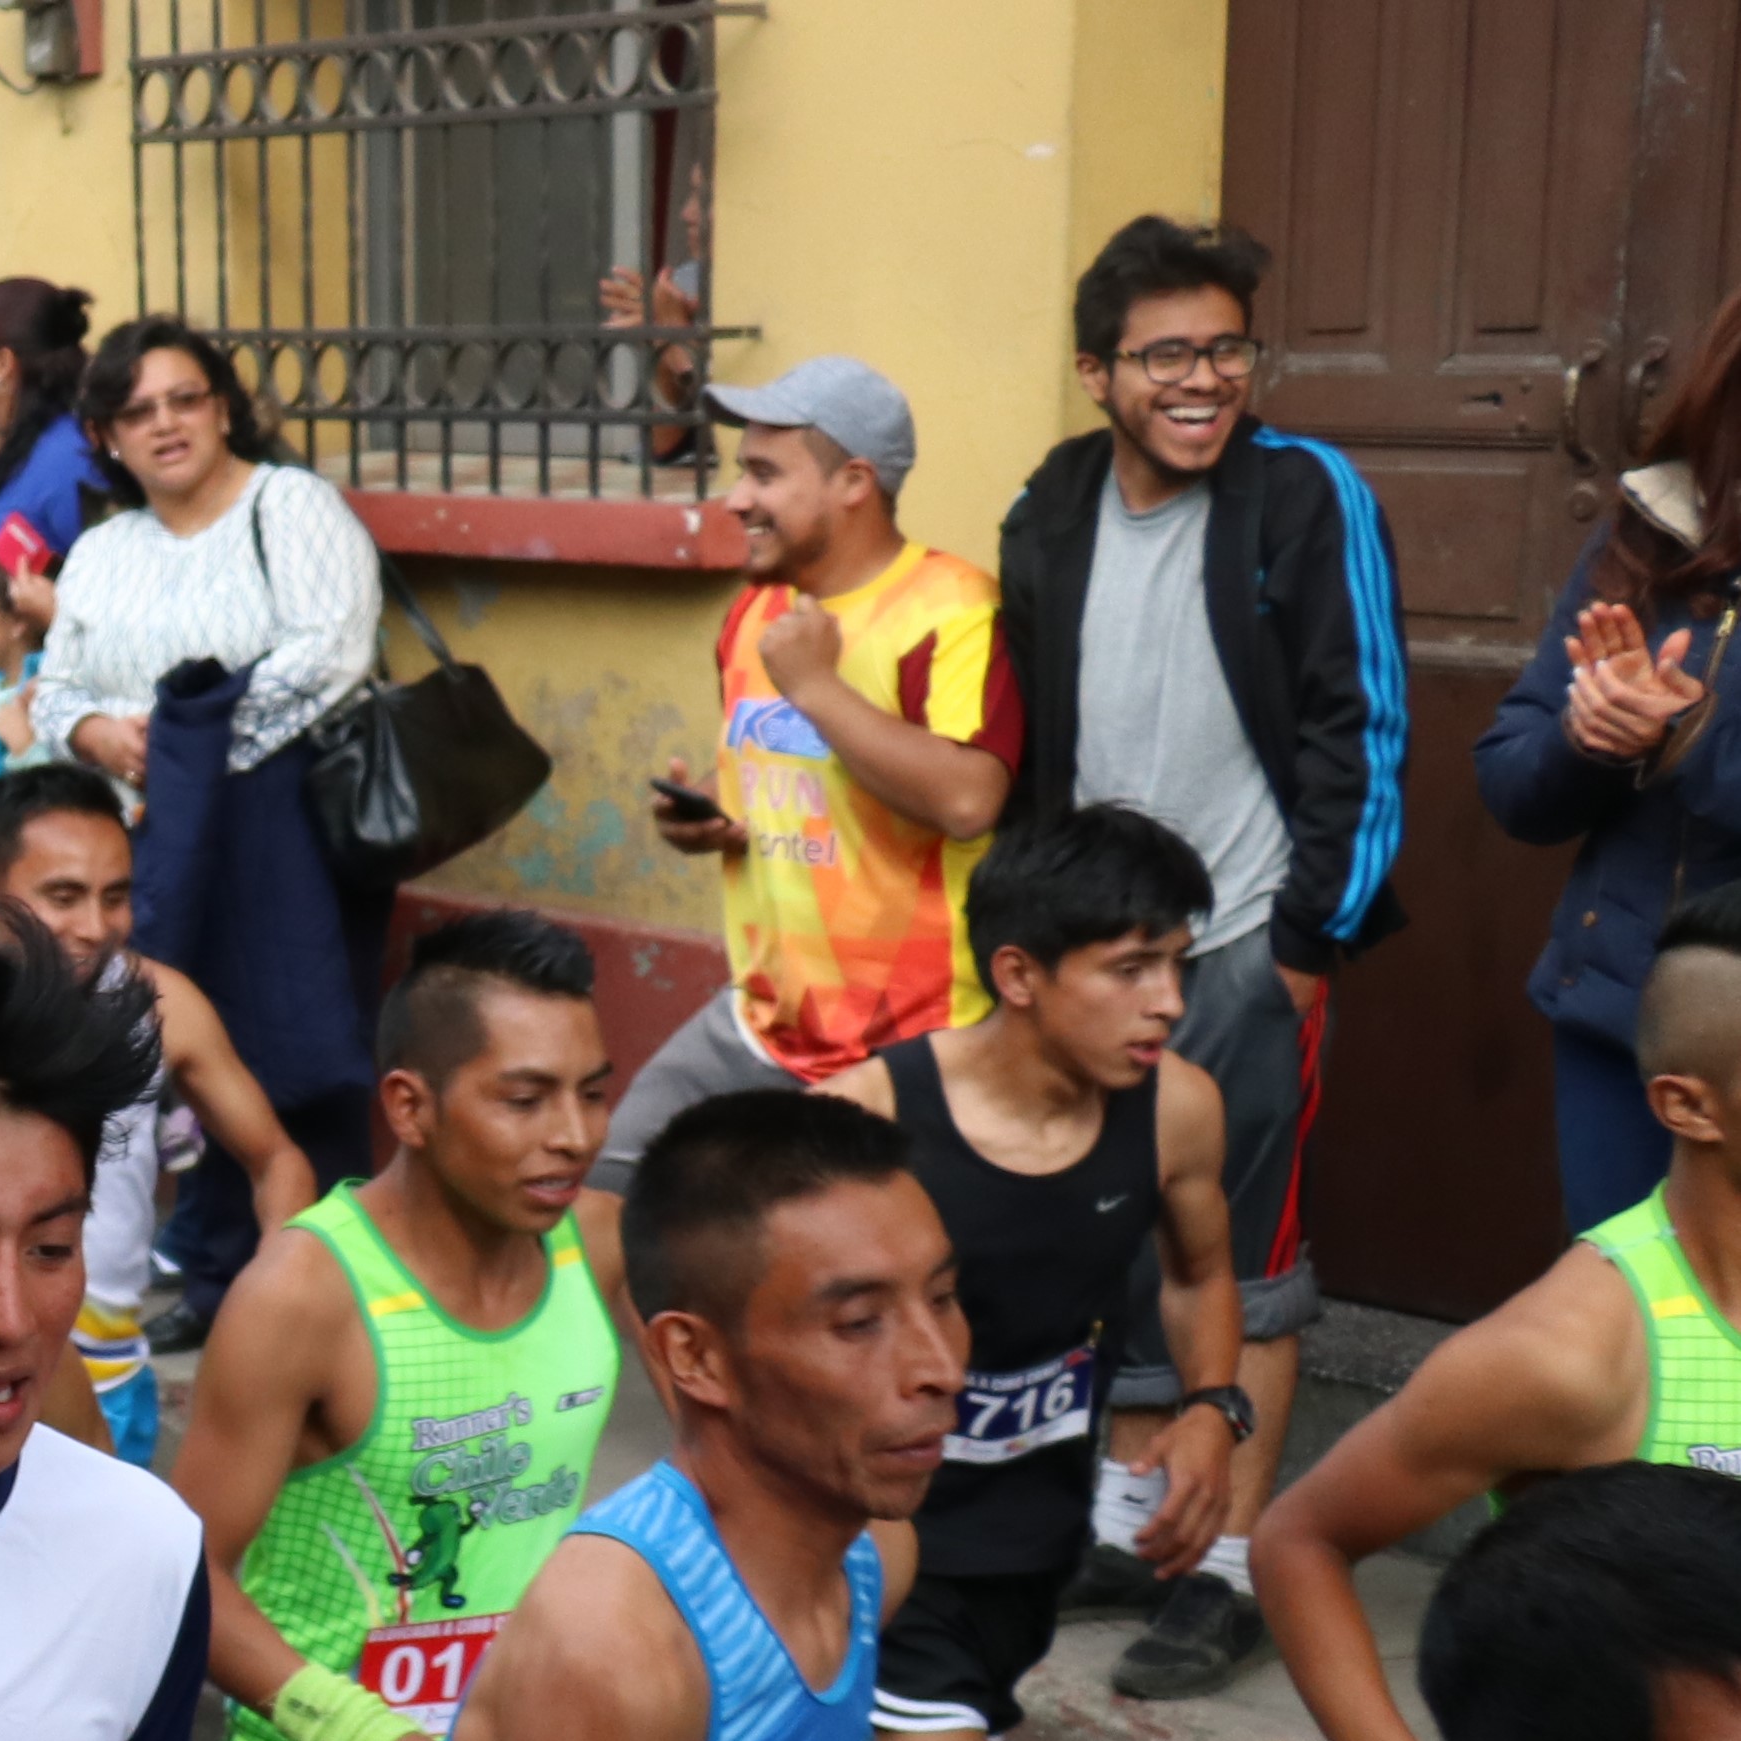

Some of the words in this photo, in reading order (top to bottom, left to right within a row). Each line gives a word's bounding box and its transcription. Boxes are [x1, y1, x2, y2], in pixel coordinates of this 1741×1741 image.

[756, 832, 836, 868] antel
[412, 1393, 532, 1450] Runner's
[966, 1371, 1076, 1438] 716
[411, 1433, 532, 1497] Chile
[380, 1641, 474, 1704] 01
